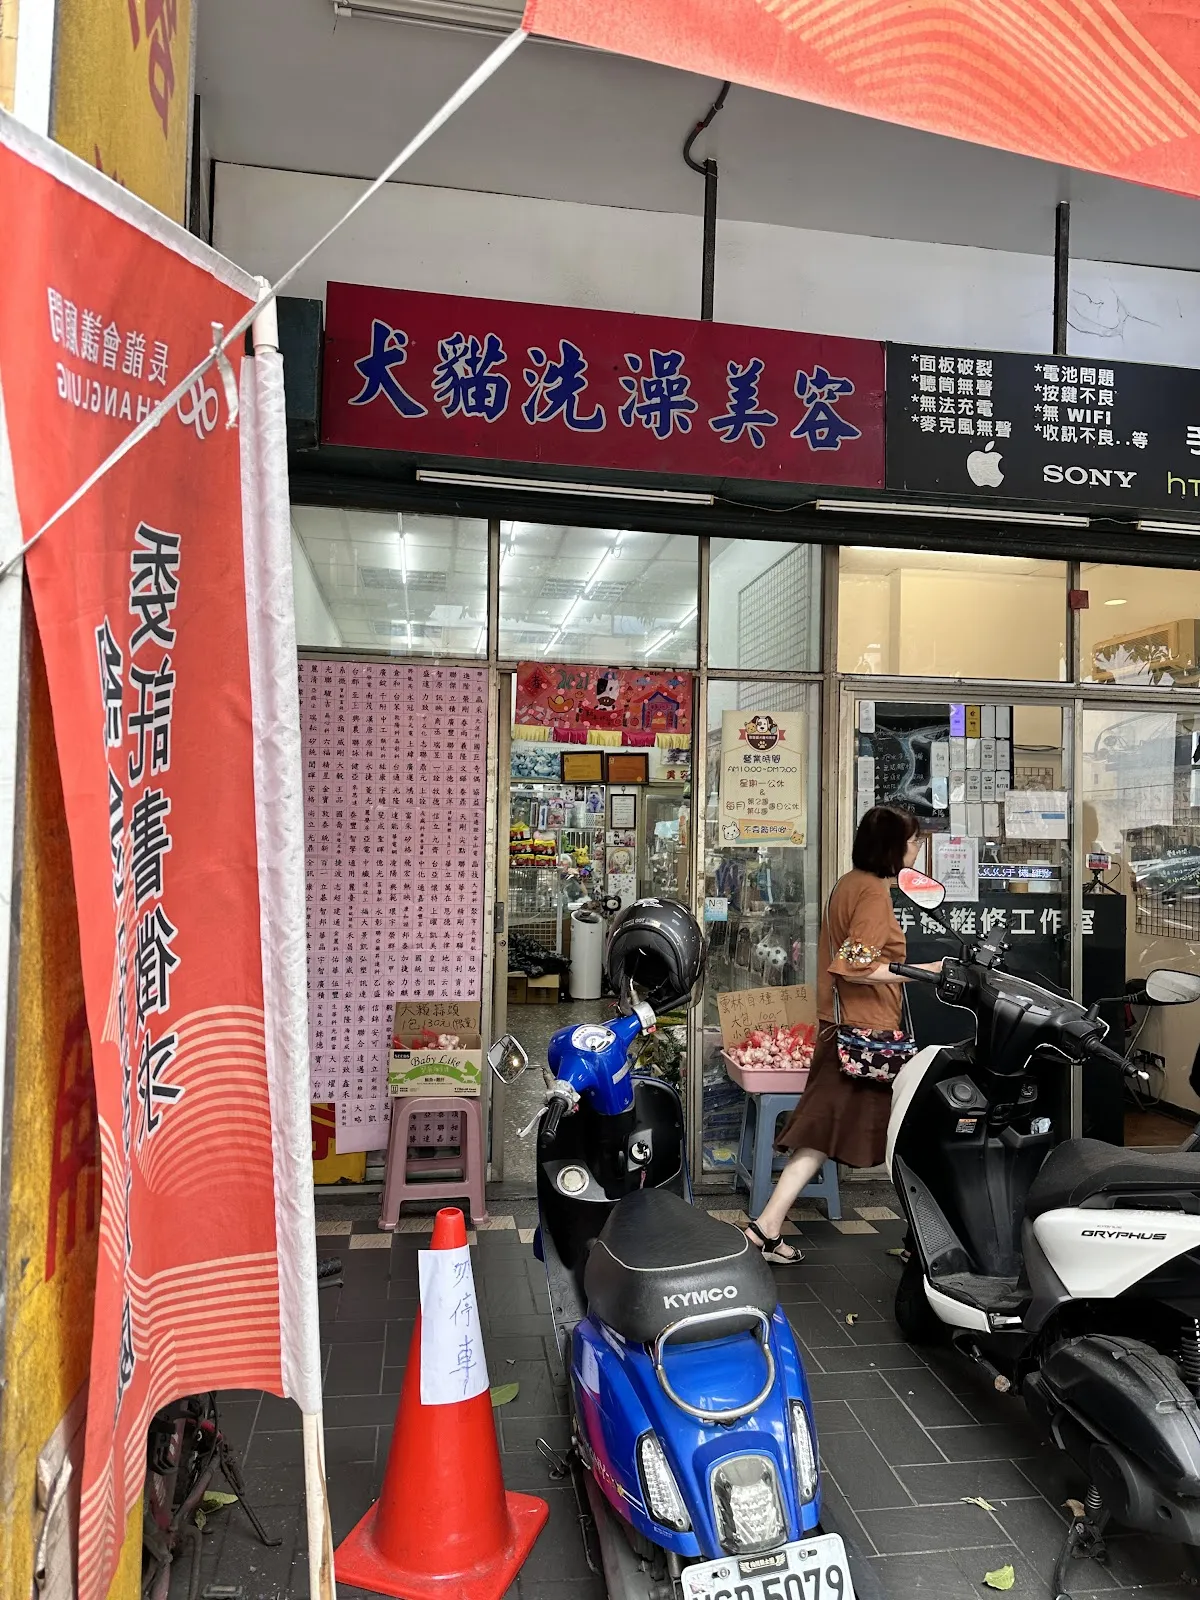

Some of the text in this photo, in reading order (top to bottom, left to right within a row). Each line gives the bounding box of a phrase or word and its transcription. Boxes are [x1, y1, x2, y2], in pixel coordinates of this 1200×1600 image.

[348, 318, 861, 452] 犬貓洗澡美容
[1067, 408, 1111, 425] WIFI
[1043, 465, 1137, 488] SONY
[1081, 1230, 1167, 1240] GRYPHUS
[663, 1285, 738, 1309] KYMCO
